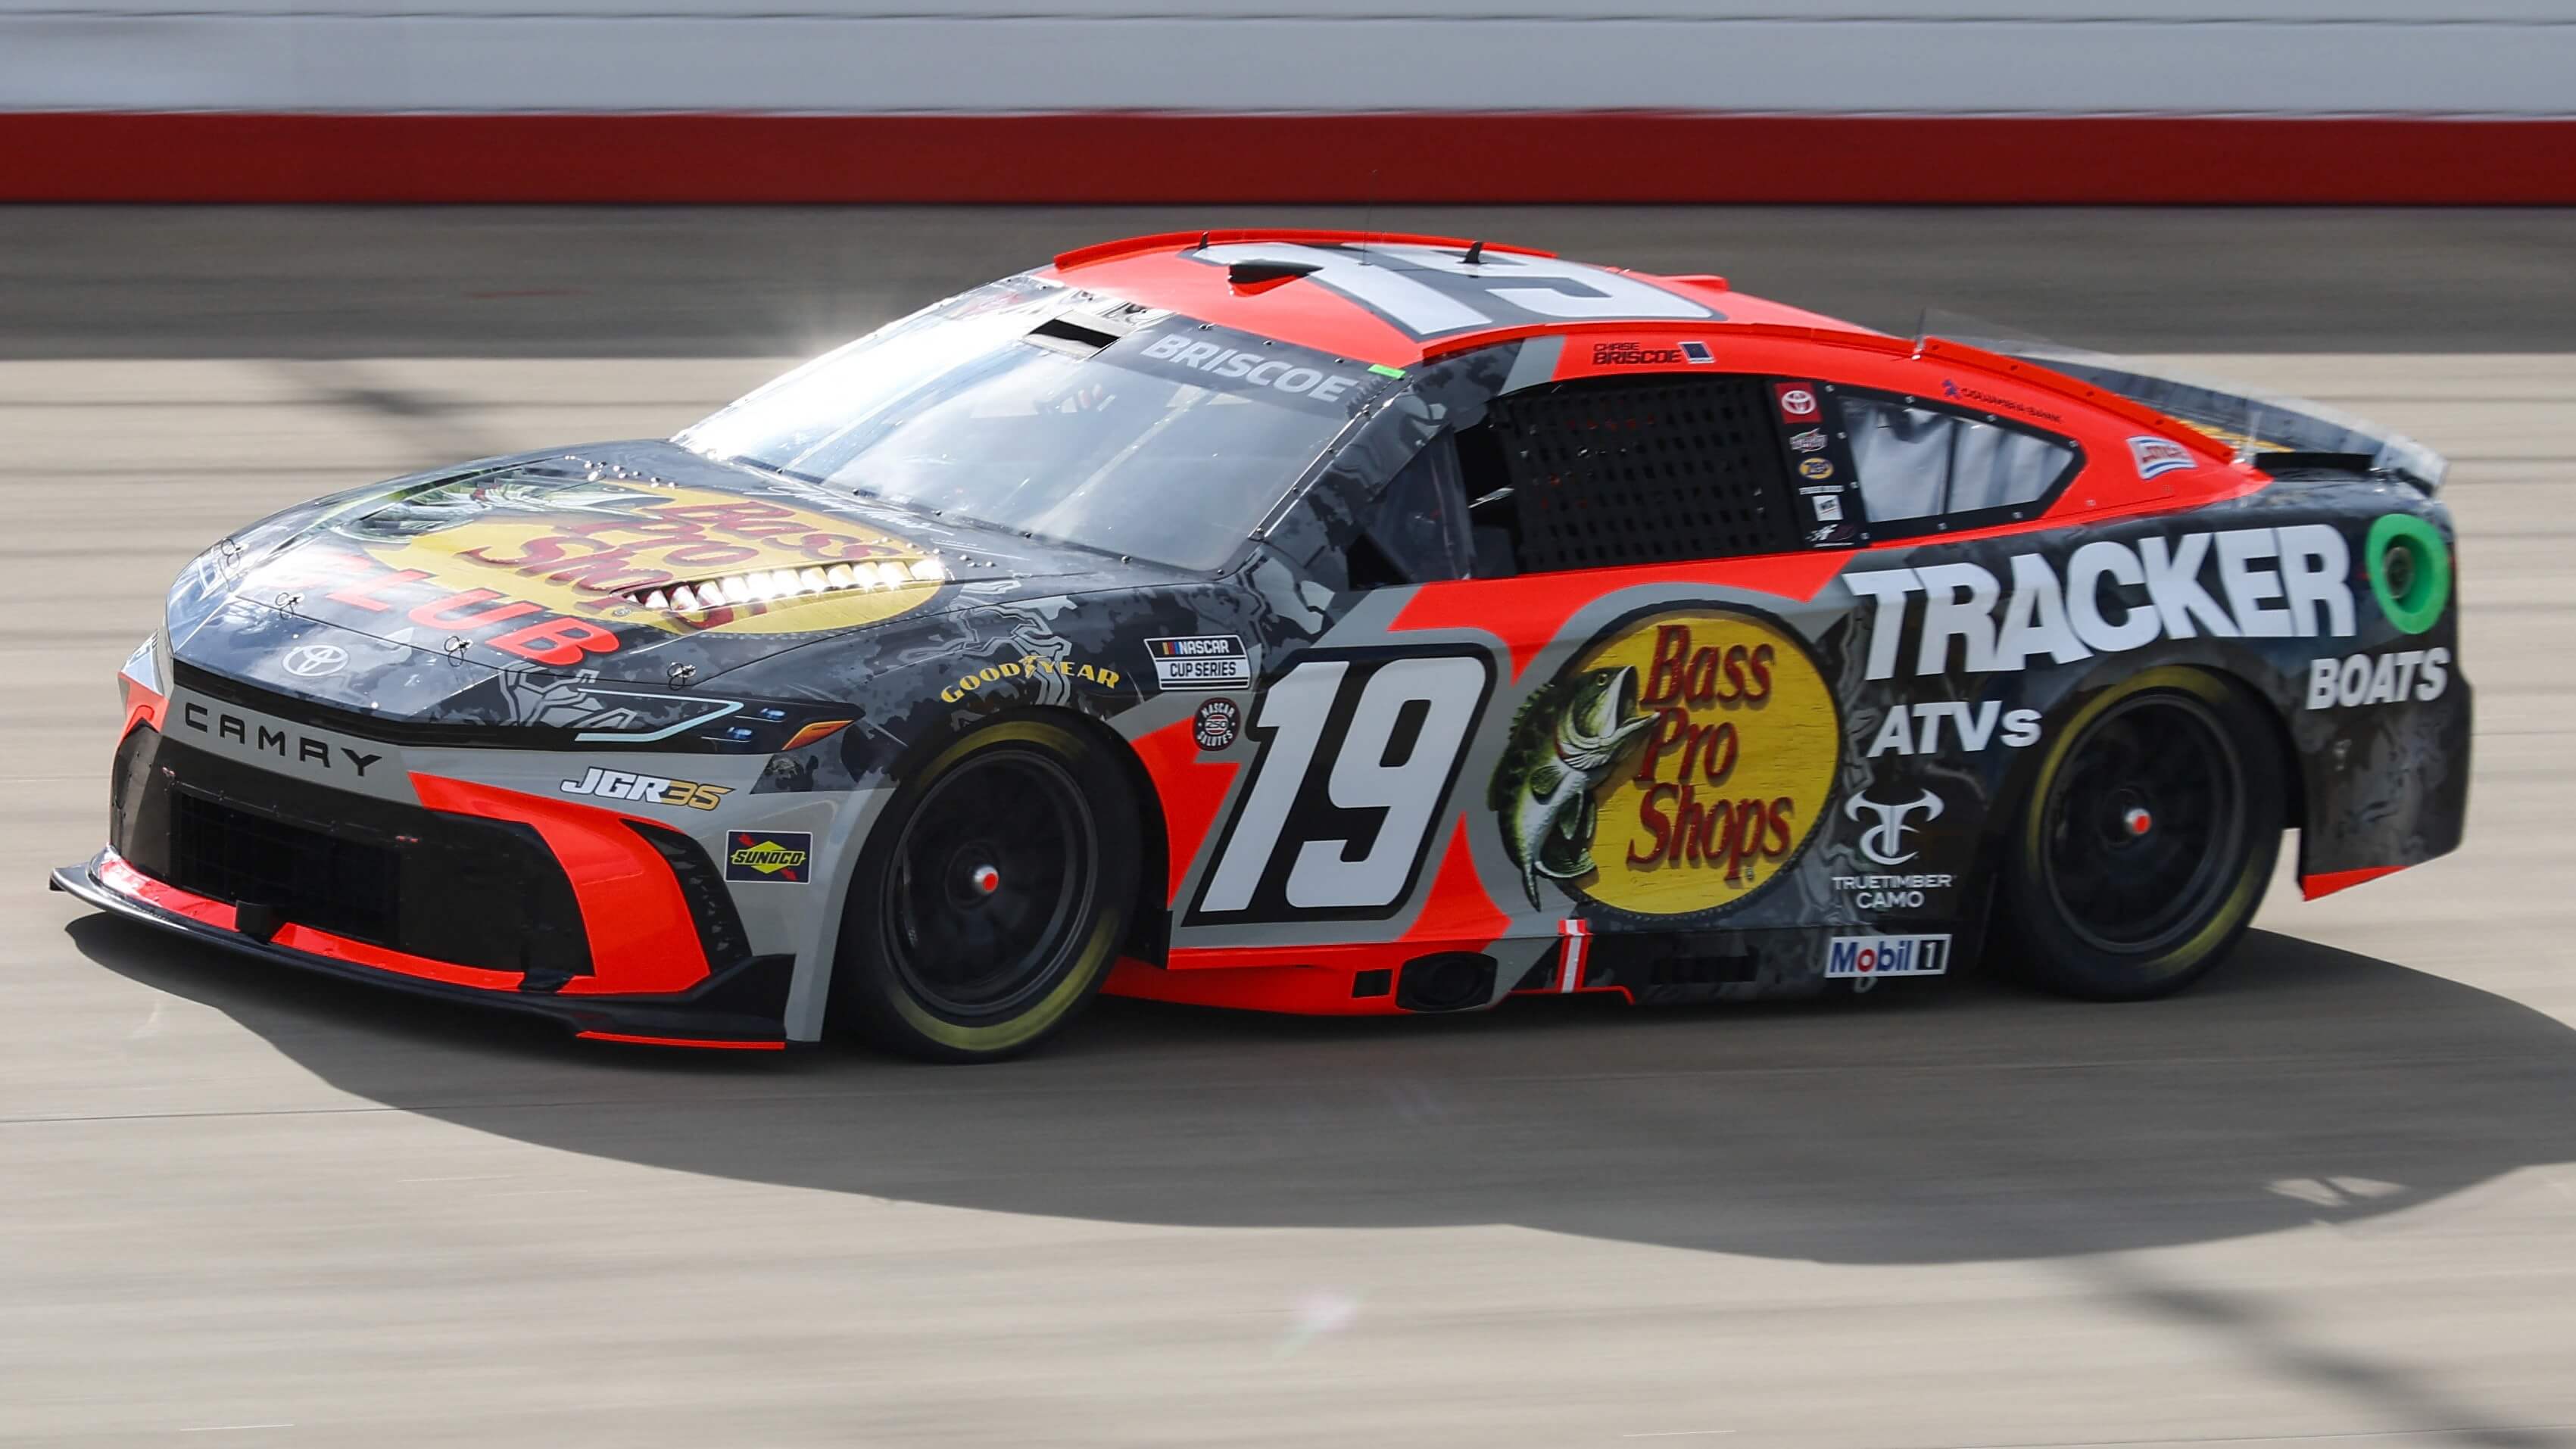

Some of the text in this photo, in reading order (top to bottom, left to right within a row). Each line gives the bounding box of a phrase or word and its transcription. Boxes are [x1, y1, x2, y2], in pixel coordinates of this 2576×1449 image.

[1193, 241, 1713, 335] 19
[1140, 334, 1360, 403] BRISCOE
[1592, 349, 1682, 365] BRISCOE
[1593, 342, 1640, 351] CHASE
[551, 516, 759, 567] Pro
[636, 500, 903, 559] Bass
[456, 534, 767, 630] Sho
[1842, 524, 2356, 681] TRACKER
[1170, 662, 1236, 677] CUP SERIES
[1179, 640, 1230, 654] NASCAR
[1639, 624, 1776, 704] Bass
[940, 656, 1120, 703] GOODYEAR
[2306, 647, 2450, 710] BOATS
[1201, 703, 1235, 718] NASCAR
[1866, 700, 2042, 758] ATVs
[184, 702, 382, 777] CAMRY
[1197, 730, 1233, 746] SALUTES
[1633, 707, 1739, 782] Pro
[560, 766, 736, 811] JGR35
[1199, 658, 1488, 911] 19
[1626, 782, 1795, 882] Shops
[733, 851, 803, 865] SUNOCO
[1832, 874, 1952, 890] TRUETIMBER
[1856, 891, 1924, 908] CAMO
[1829, 940, 1937, 973] Mobil 1
